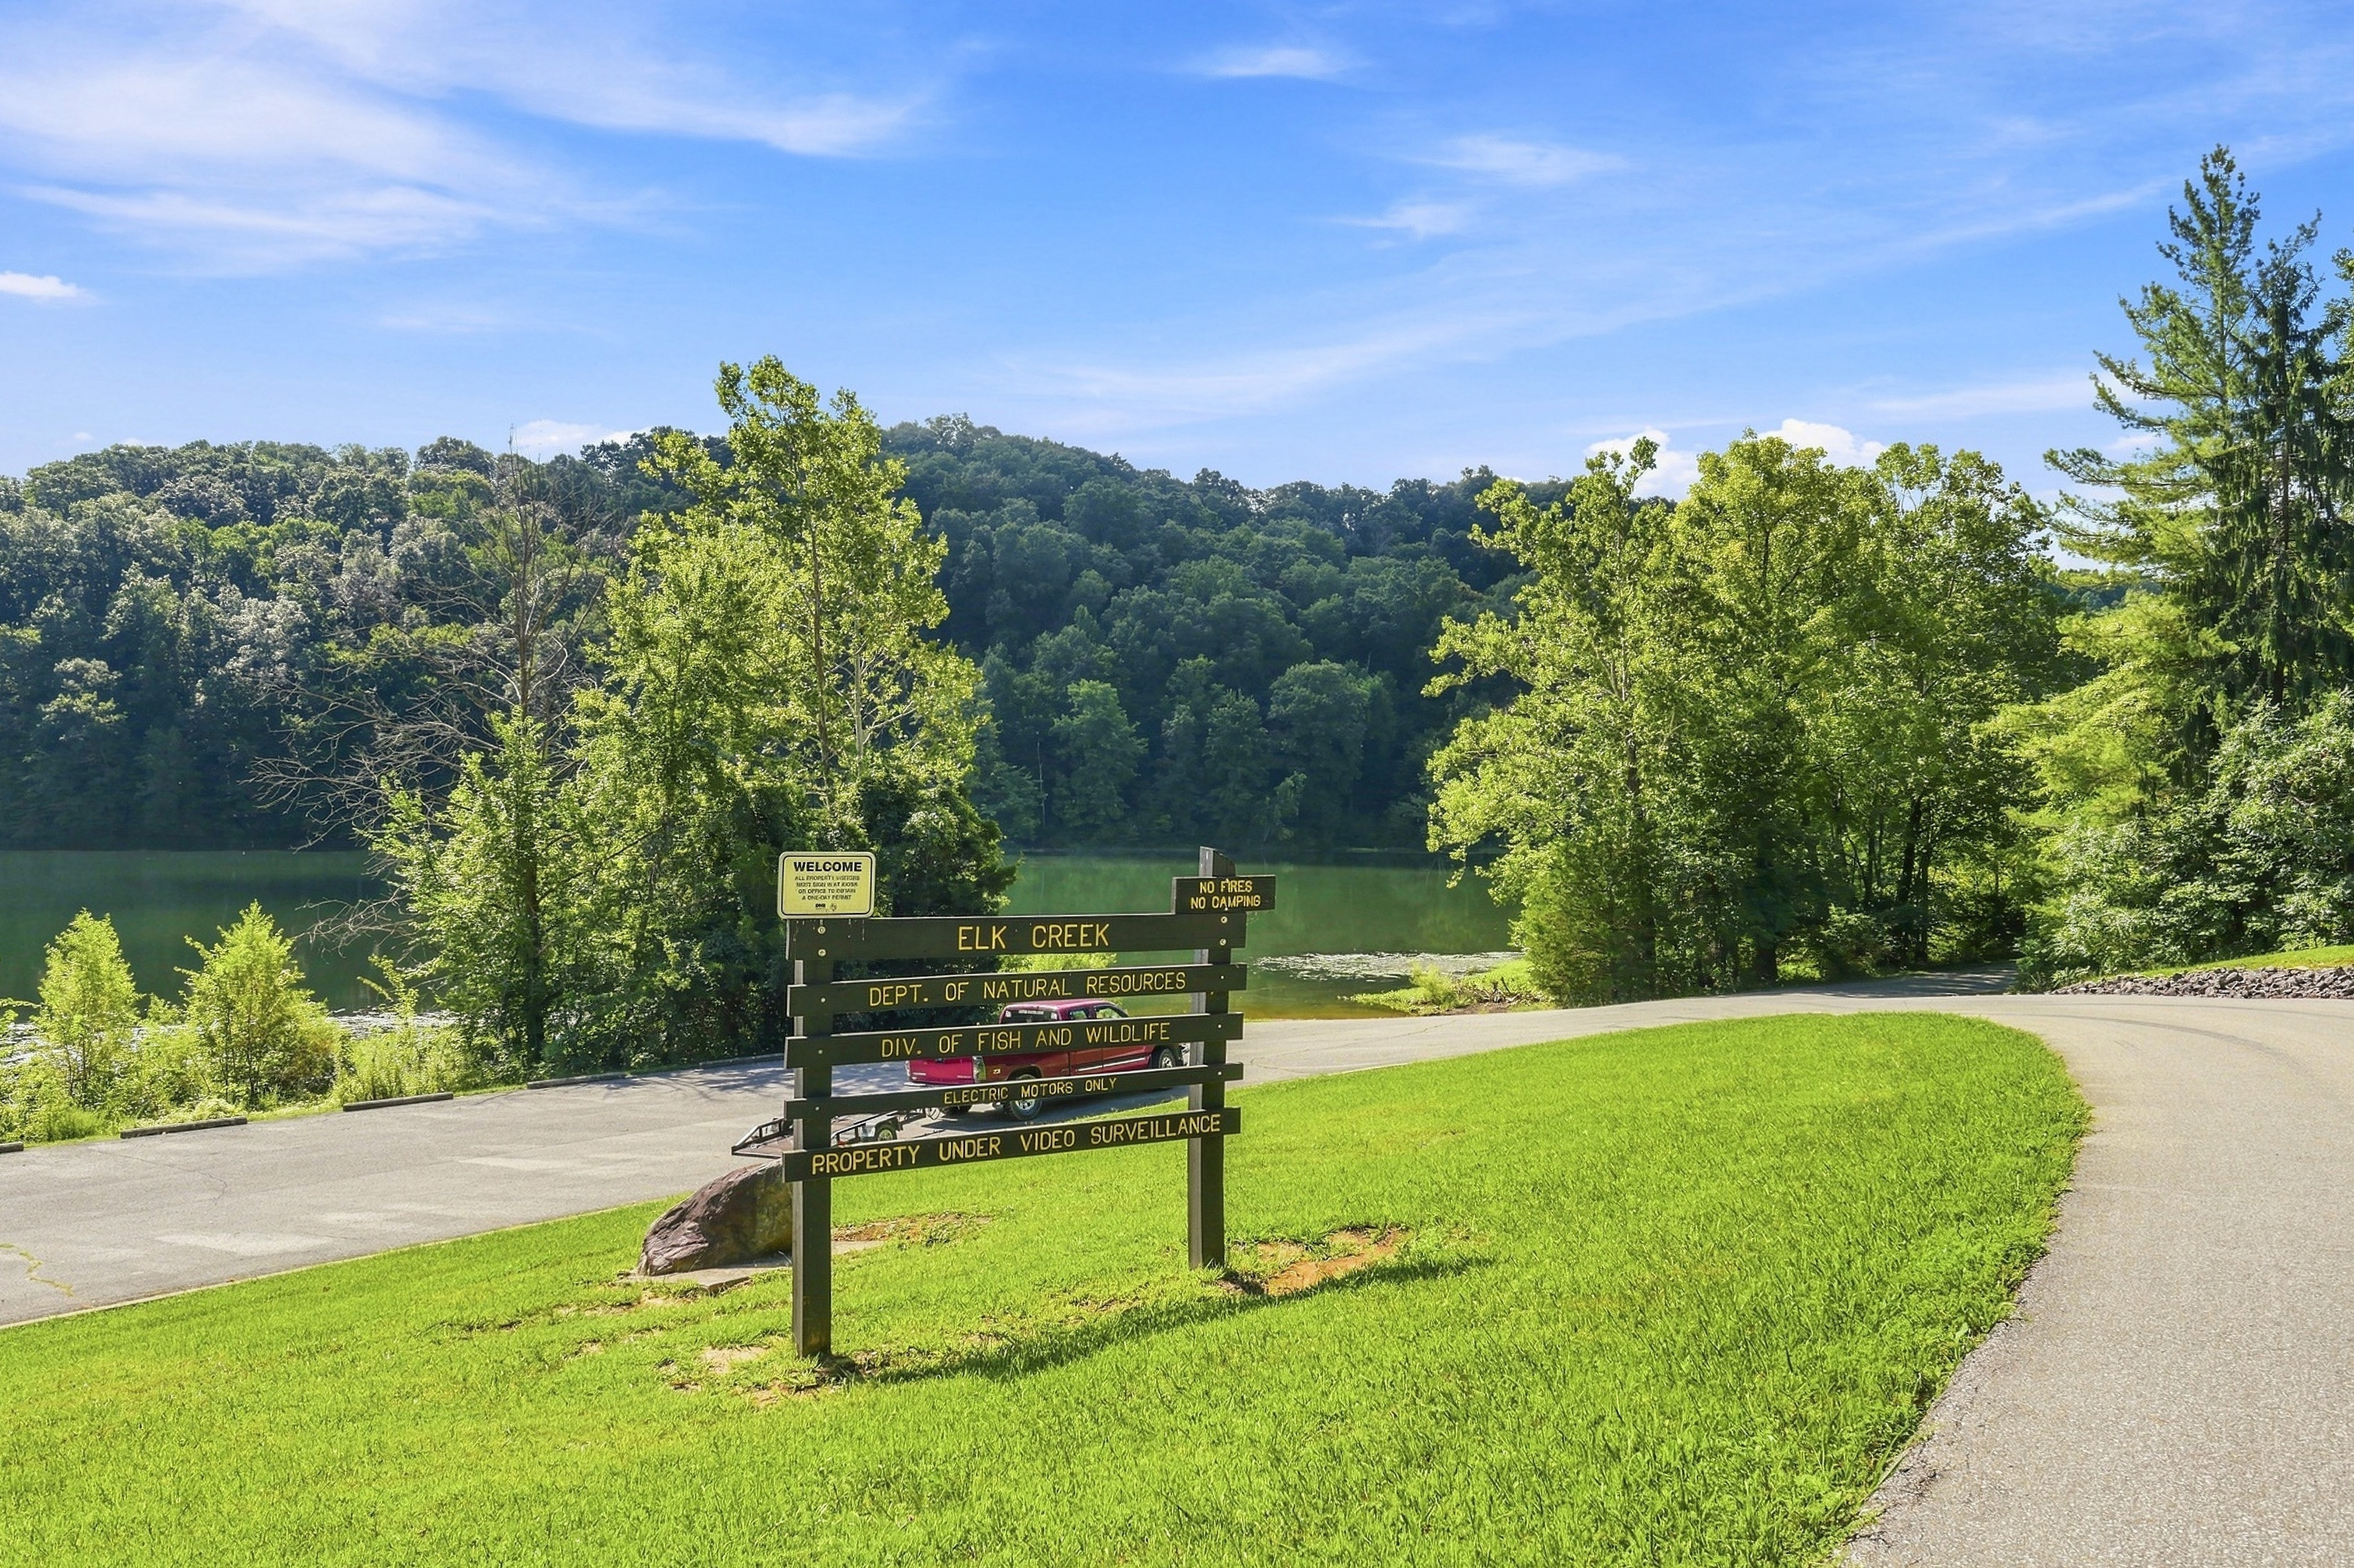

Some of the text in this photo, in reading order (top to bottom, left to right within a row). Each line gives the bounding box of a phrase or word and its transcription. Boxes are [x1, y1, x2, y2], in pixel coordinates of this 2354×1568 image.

[794, 862, 862, 872] WELCOME
[1200, 880, 1252, 894] NO FIRES
[1190, 895, 1261, 909] NO CAMPING
[958, 924, 1109, 950] ELK CREEK
[869, 972, 1186, 1006] DEPT. OF NATURAL RESOURCES
[882, 1022, 1170, 1058] DIV. OF FISH AND WILDLIFE
[944, 1078, 1117, 1105] ELECTRIC MOTORS ONLY
[812, 1114, 1221, 1175] PROPERTY UNDER VIDEO SURVEILLANCE
